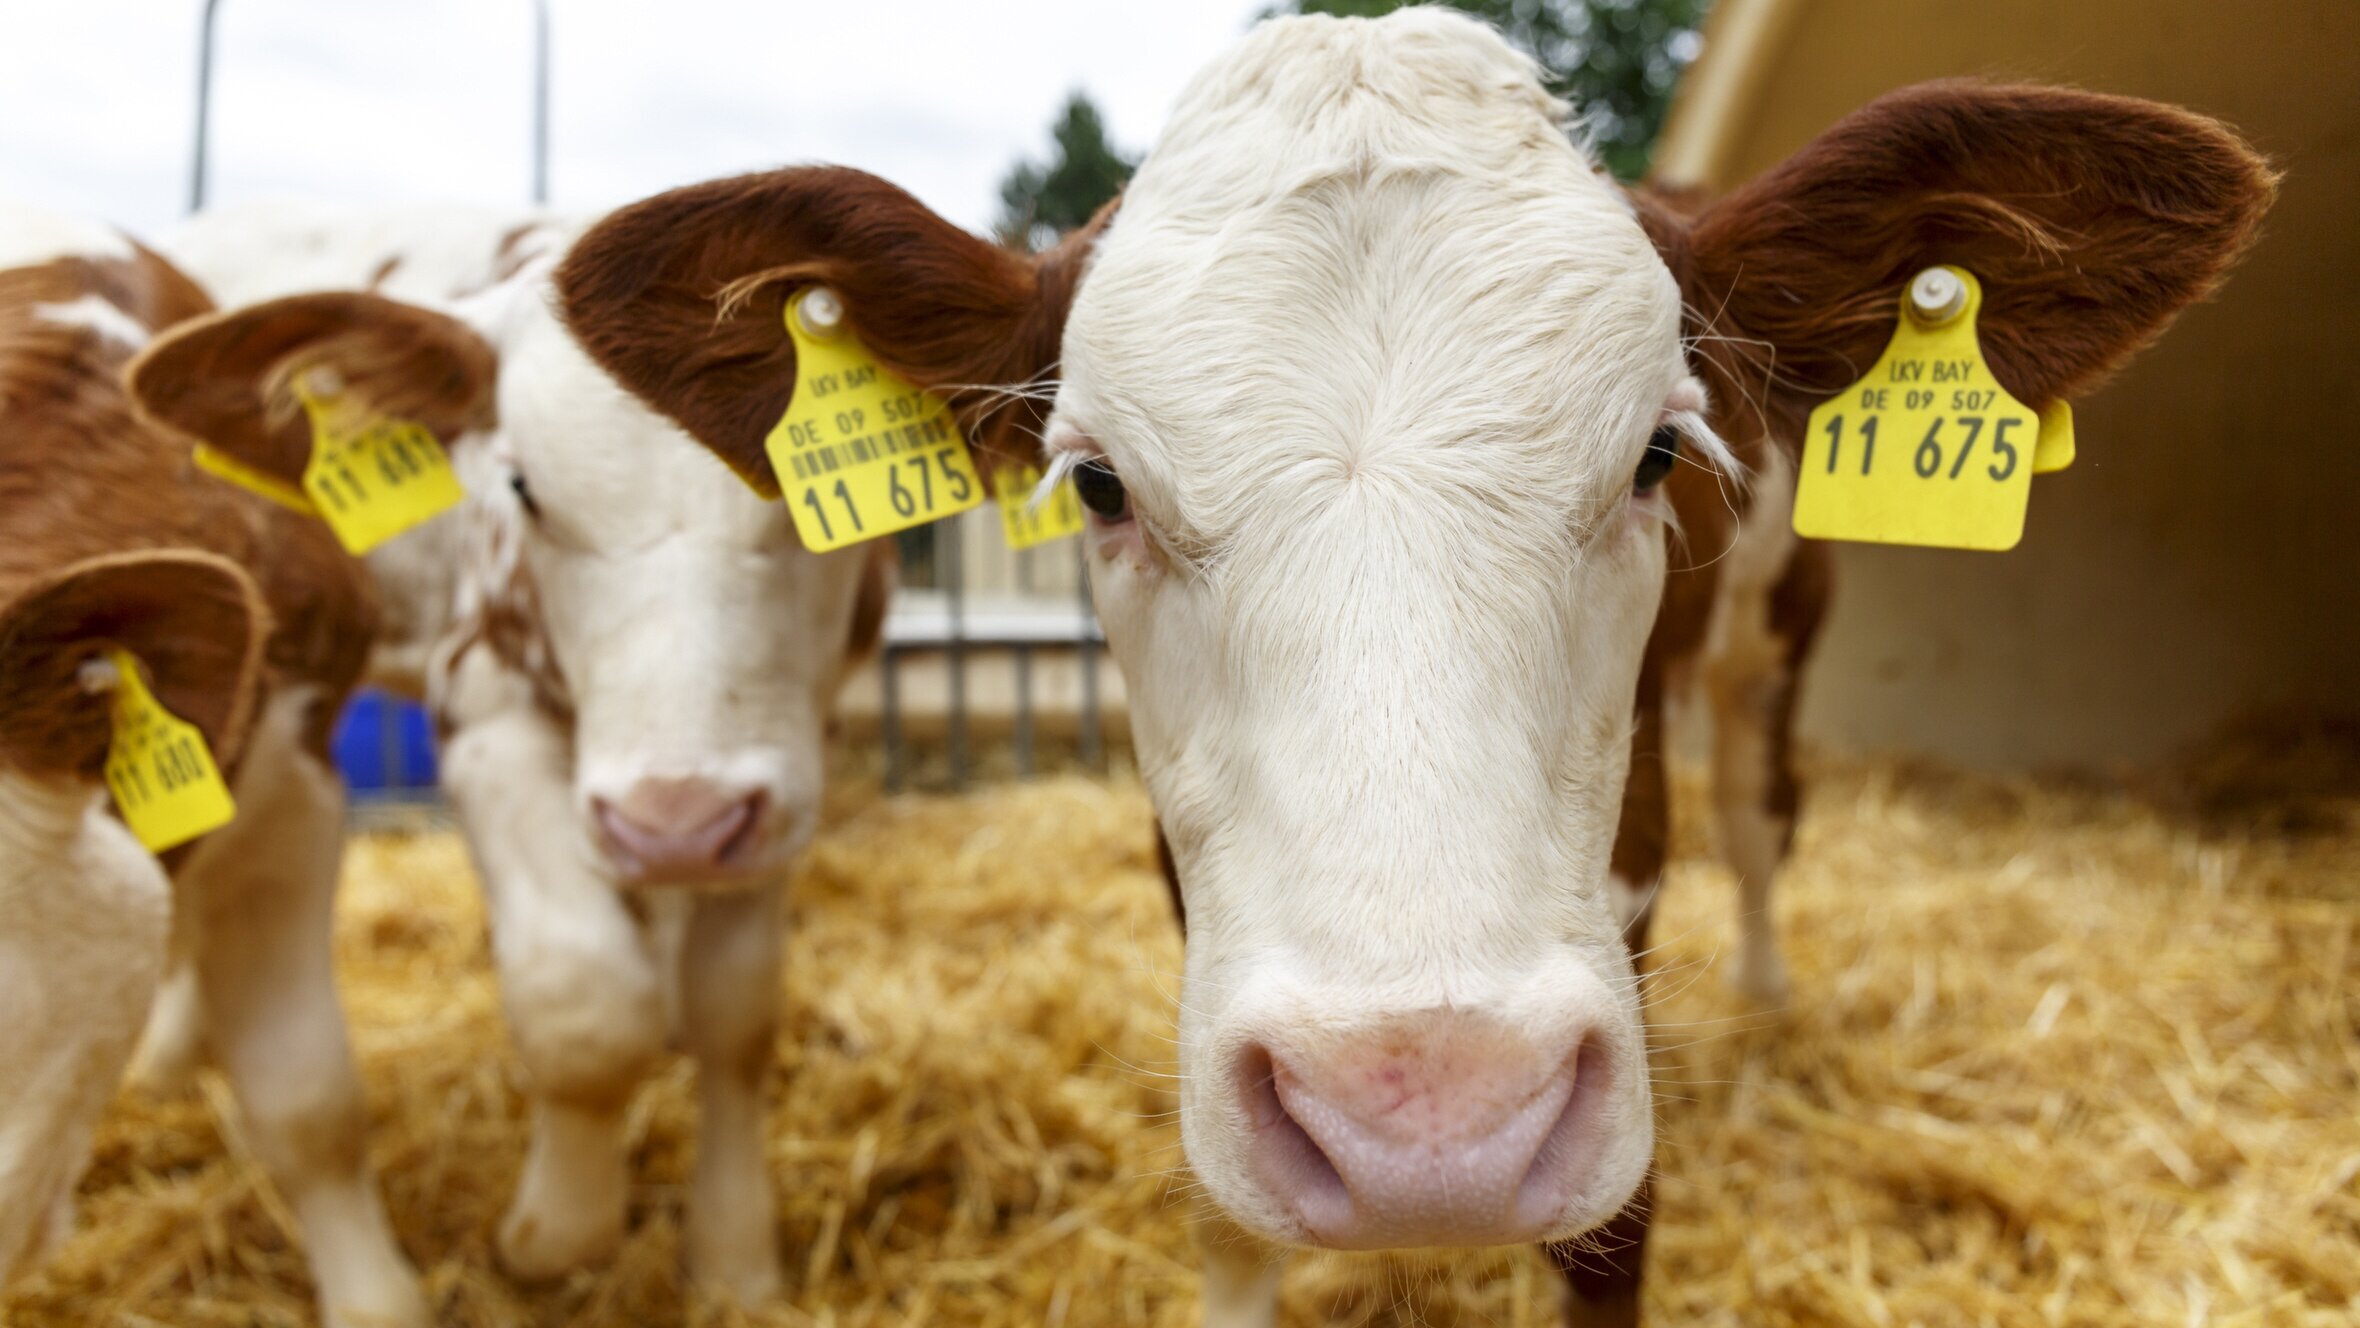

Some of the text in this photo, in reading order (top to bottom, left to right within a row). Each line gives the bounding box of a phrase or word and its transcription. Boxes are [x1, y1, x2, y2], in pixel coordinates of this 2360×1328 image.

[845, 364, 877, 389] BAY
[1890, 360, 1973, 382] LKV BAY
[788, 392, 924, 447] DE 09 507
[1861, 389, 1995, 411] DE 09 507
[1825, 414, 2022, 482] 11 675
[804, 478, 863, 540] 11
[888, 448, 970, 518] 675
